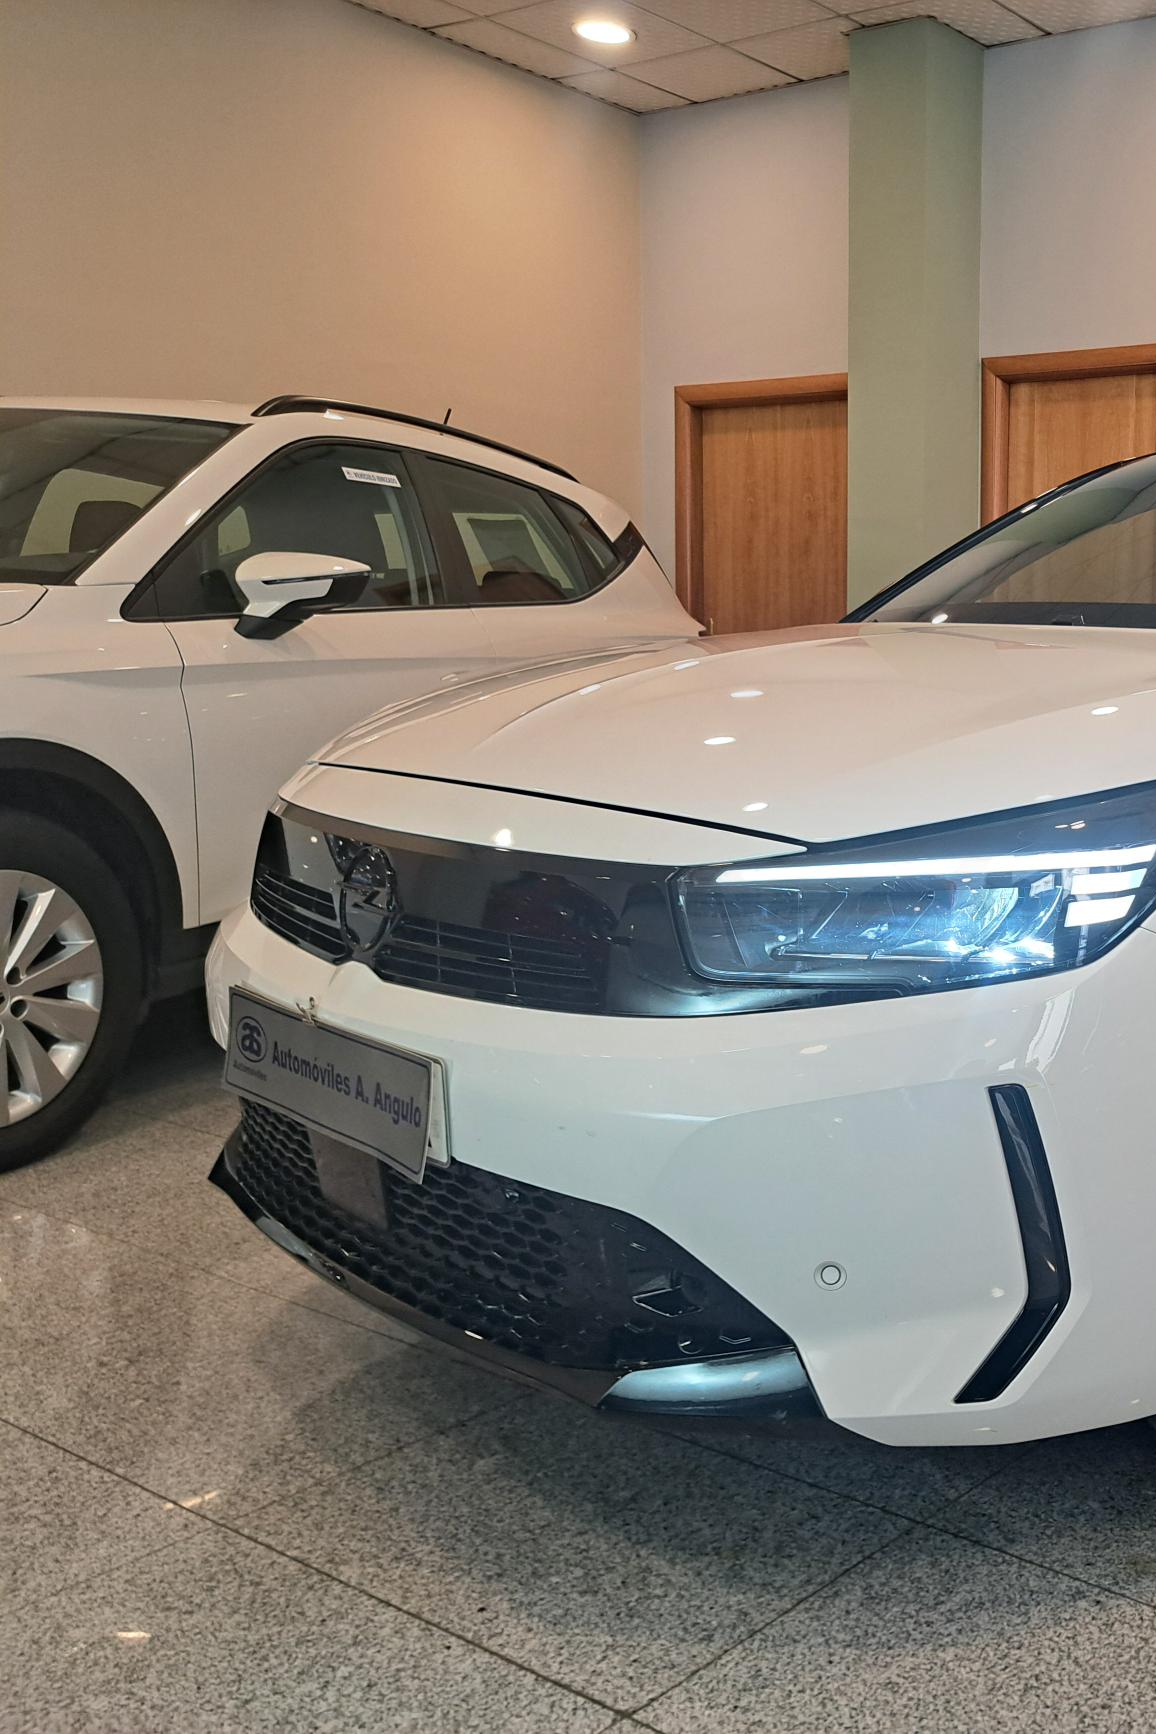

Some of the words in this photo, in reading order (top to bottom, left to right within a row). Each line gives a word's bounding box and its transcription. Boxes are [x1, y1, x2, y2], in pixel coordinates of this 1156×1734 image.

[272, 1041, 351, 1096] Automóviles
[355, 1075, 369, 1104] A.
[374, 1082, 422, 1128] Angulo
